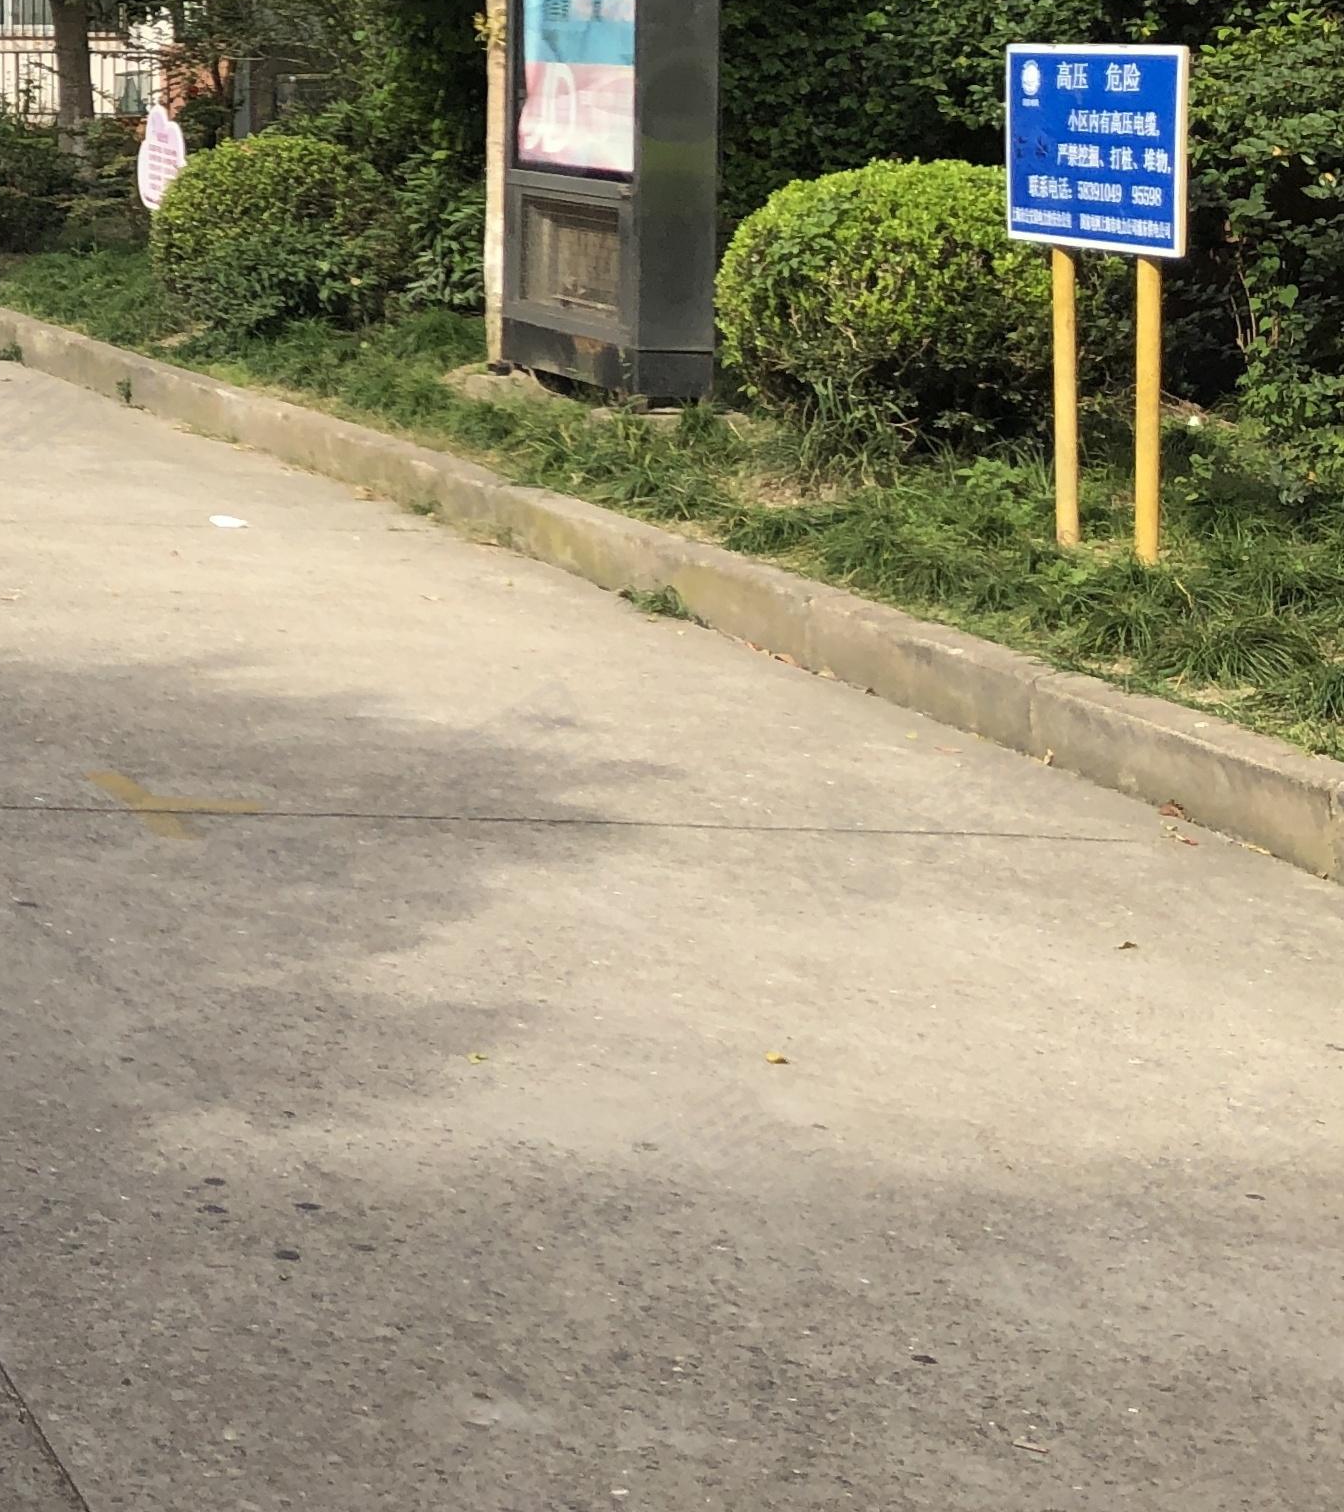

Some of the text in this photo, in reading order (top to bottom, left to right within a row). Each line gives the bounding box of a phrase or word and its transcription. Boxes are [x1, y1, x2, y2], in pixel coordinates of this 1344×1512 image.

[1056, 61, 1141, 92] 高压 危险
[1131, 186, 1162, 207] 95598
